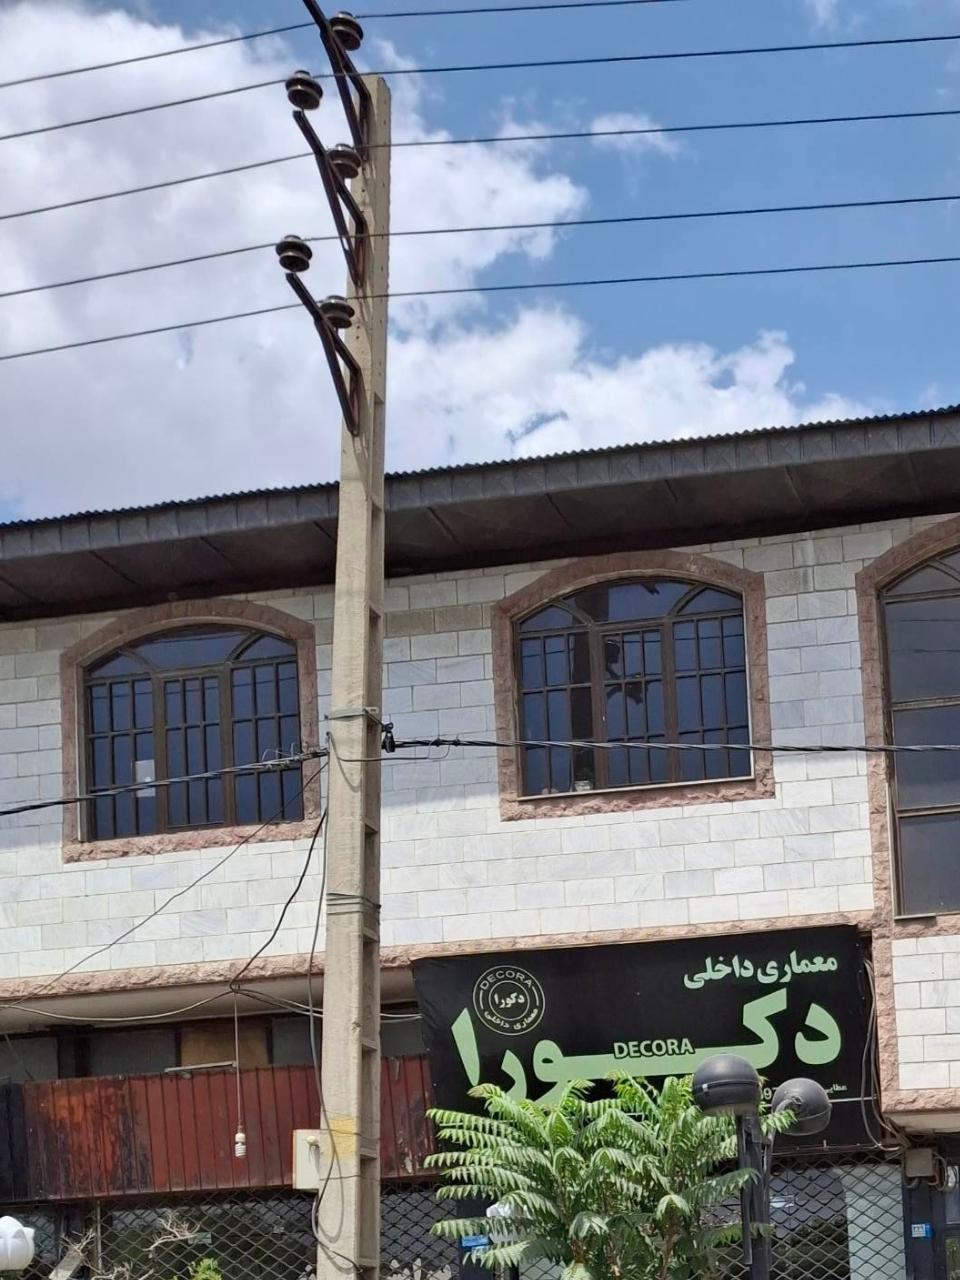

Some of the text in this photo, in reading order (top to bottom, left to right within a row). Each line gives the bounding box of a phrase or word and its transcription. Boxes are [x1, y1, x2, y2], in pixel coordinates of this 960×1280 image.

[480, 970, 532, 991] DECORA
[683, 950, 838, 990] معماری داخلی
[493, 992, 525, 1008] دکورا
[484, 1008, 538, 1030] معماری داخلی
[451, 988, 842, 1102] دکورا
[613, 1038, 695, 1059] DECORA
